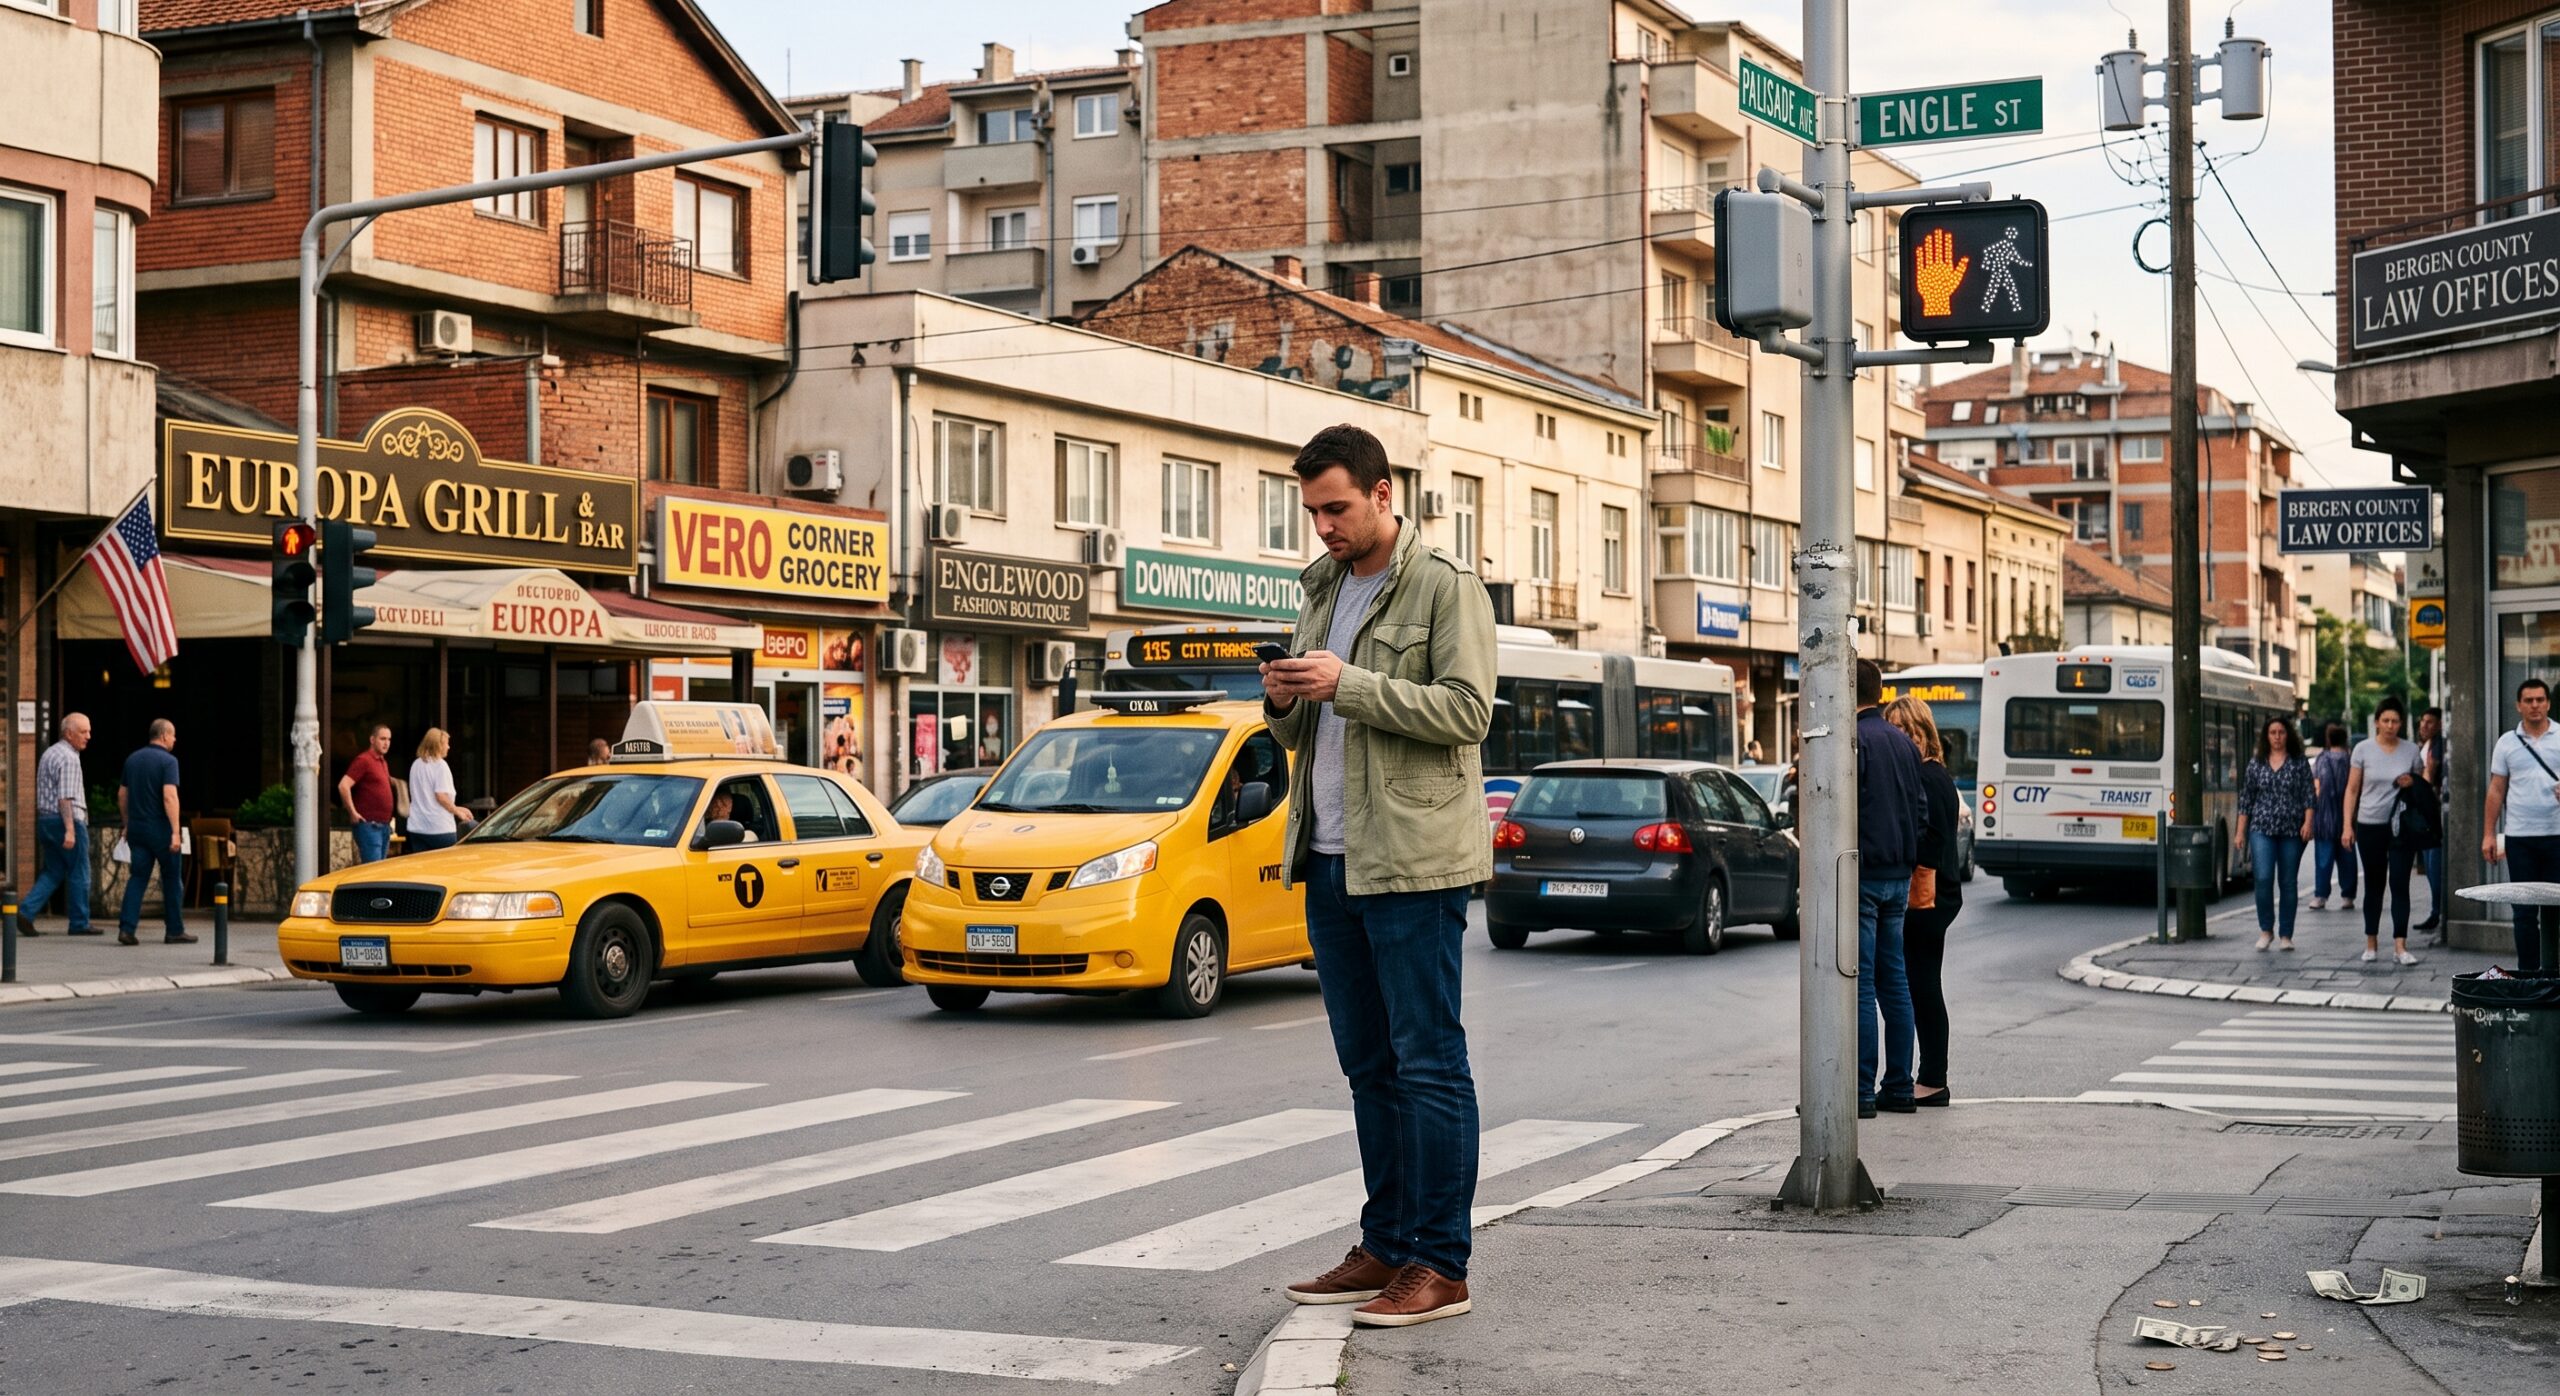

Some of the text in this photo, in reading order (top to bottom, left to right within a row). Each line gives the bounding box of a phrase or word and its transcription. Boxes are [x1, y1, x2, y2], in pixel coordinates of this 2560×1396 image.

[1742, 66, 1814, 136] PALISADE AVE
[1880, 92, 2022, 138] ENGLE ST
[2385, 231, 2533, 284] BERGEN COUNTY
[2363, 258, 2560, 332] LAW OFFICES
[186, 451, 569, 544] EUROPA GRILL
[578, 491, 595, 518] &
[2288, 498, 2420, 518] BERGEN COUNTY
[579, 520, 625, 550] BAR
[671, 510, 772, 580] VERO
[788, 522, 875, 558] CORNER
[2287, 521, 2423, 546] LAW OFFICES
[779, 555, 882, 592] GROCERY
[939, 558, 1085, 602] ENGLEWOOD
[1135, 560, 1242, 605] DOWNTOWN
[411, 608, 444, 627] DELI
[491, 602, 603, 638] EUROPA
[953, 594, 1071, 623] FASHION BOUTIQUE
[1181, 642, 1210, 659] CITY
[2013, 786, 2152, 803] CITY TRANSIT
[740, 871, 757, 903] T
